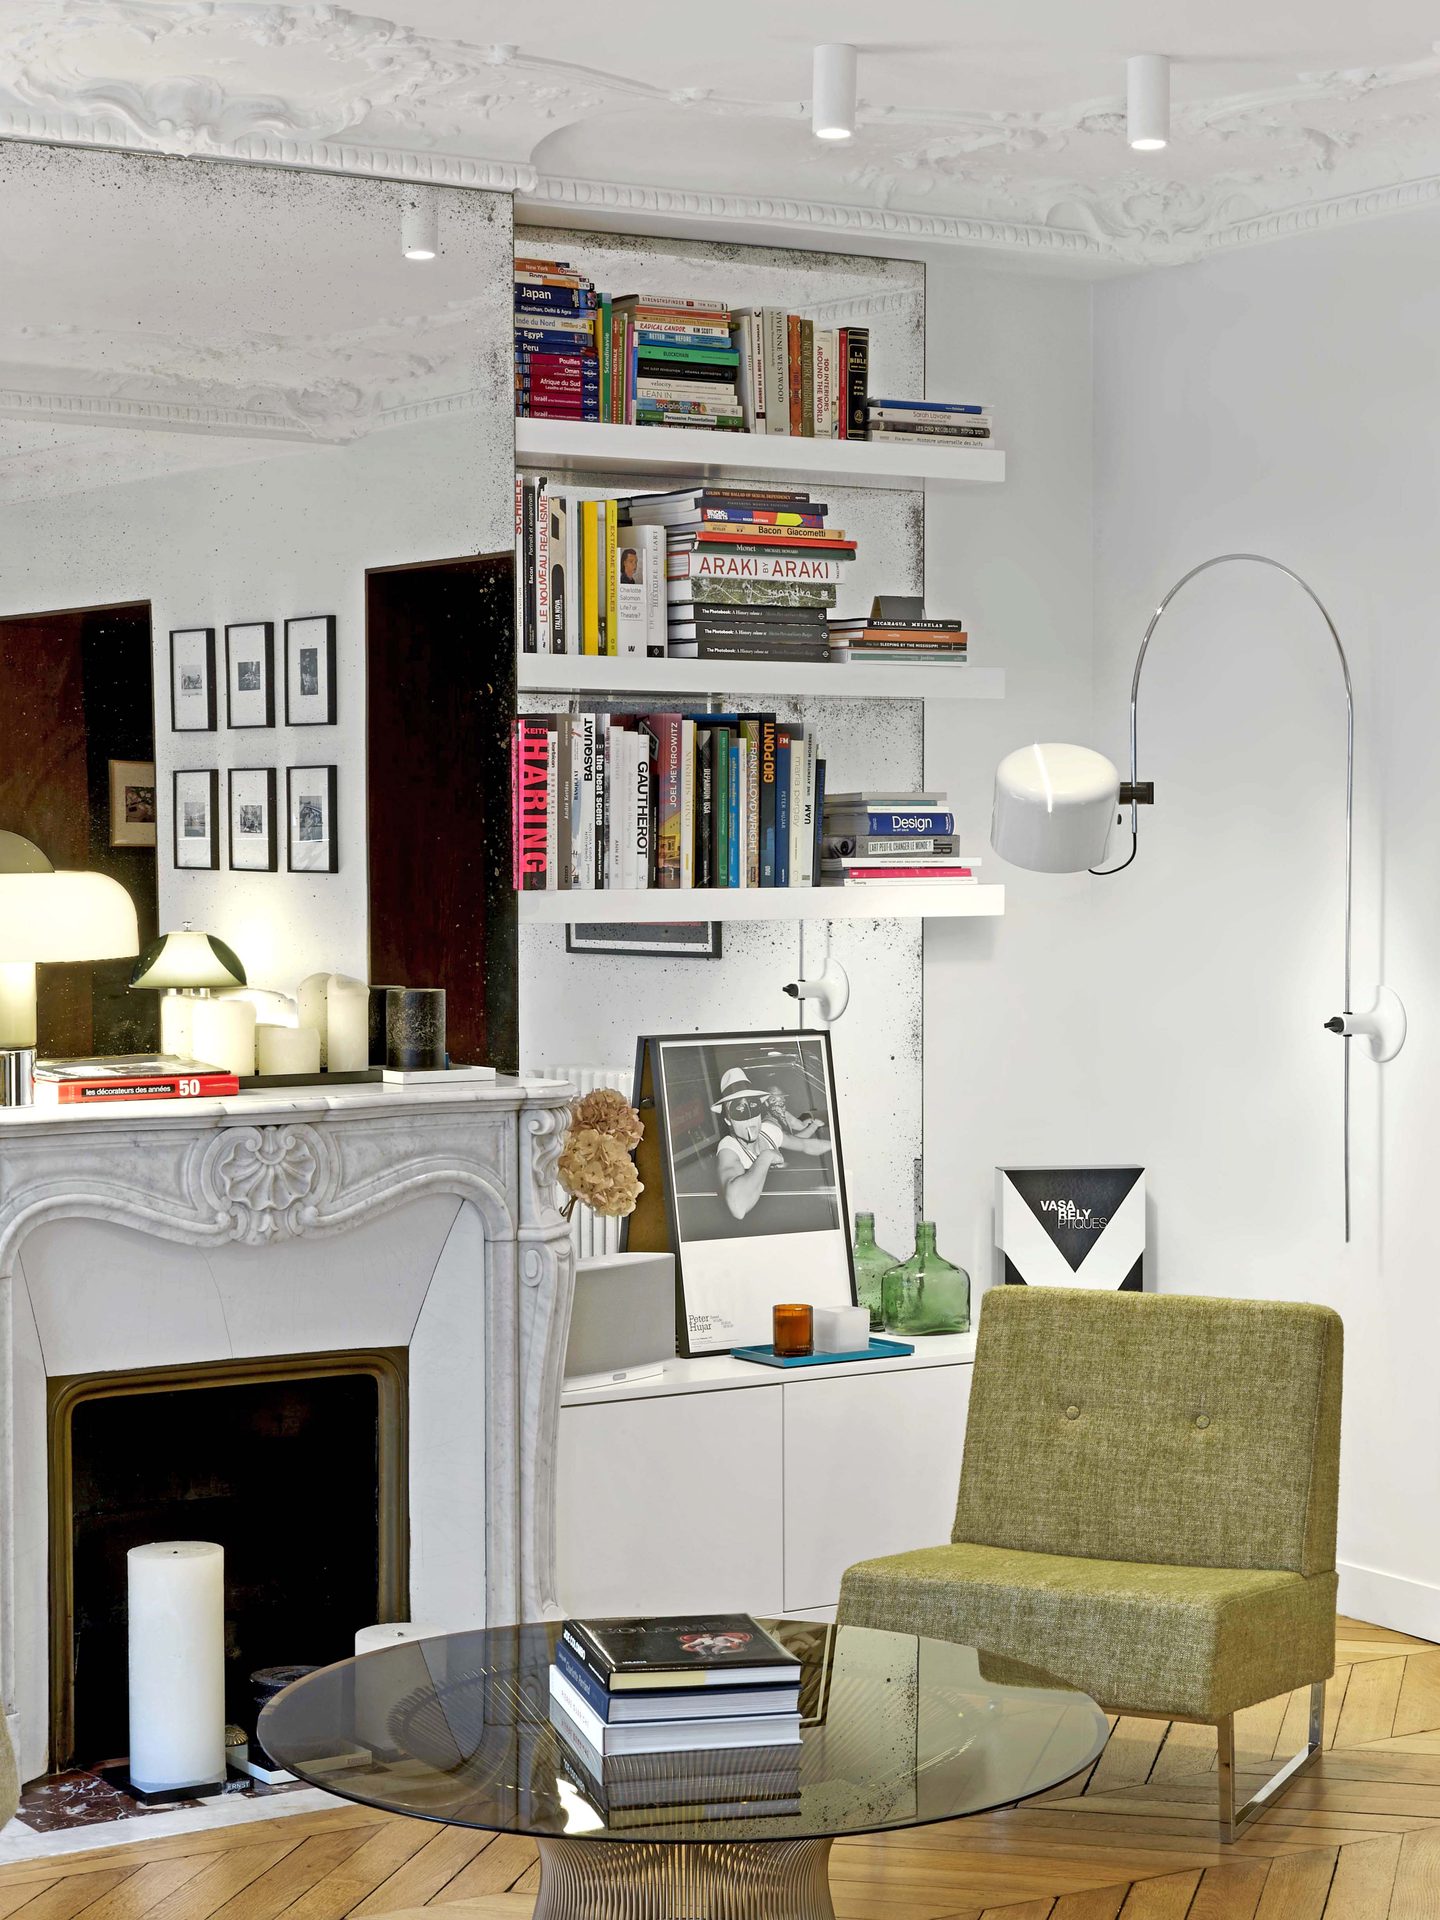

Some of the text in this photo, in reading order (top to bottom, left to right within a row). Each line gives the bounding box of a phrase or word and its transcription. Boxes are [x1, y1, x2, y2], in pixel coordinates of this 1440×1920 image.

[522, 287, 552, 300] Japan
[516, 316, 529, 325] Inde
[530, 318, 539, 326] du
[664, 324, 686, 332] CANDOR
[524, 330, 544, 340] Egypt
[522, 344, 539, 352] Peru
[804, 359, 812, 377] YORK
[540, 378, 560, 386] Afrique
[804, 380, 812, 418] ORIGINALS
[758, 526, 826, 537] Bacon Giacometti
[653, 555, 658, 565] DE
[699, 557, 828, 579] ARAKI BY ARAKI
[538, 555, 547, 605] NOUVEAU
[540, 610, 547, 623] LE
[584, 718, 593, 781] BASQUIAT
[764, 723, 774, 783] GIO PONTI
[524, 738, 548, 873] HARING
[637, 761, 648, 858] GAUTHEROT
[793, 790, 802, 827] pergay
[892, 816, 932, 832] Design
[870, 842, 878, 852] L'ART
[893, 841, 910, 851] CHANGER
[910, 841, 915, 850] LE
[915, 841, 928, 850] MONDE
[933, 839, 952, 854] JR
[179, 1080, 200, 1096] 50
[1040, 1200, 1075, 1211] VASA
[1059, 1209, 1091, 1220] RELY
[689, 1314, 709, 1324] Peter
[690, 1323, 711, 1332] Hujar
[227, 1782, 250, 1790] ERNST
